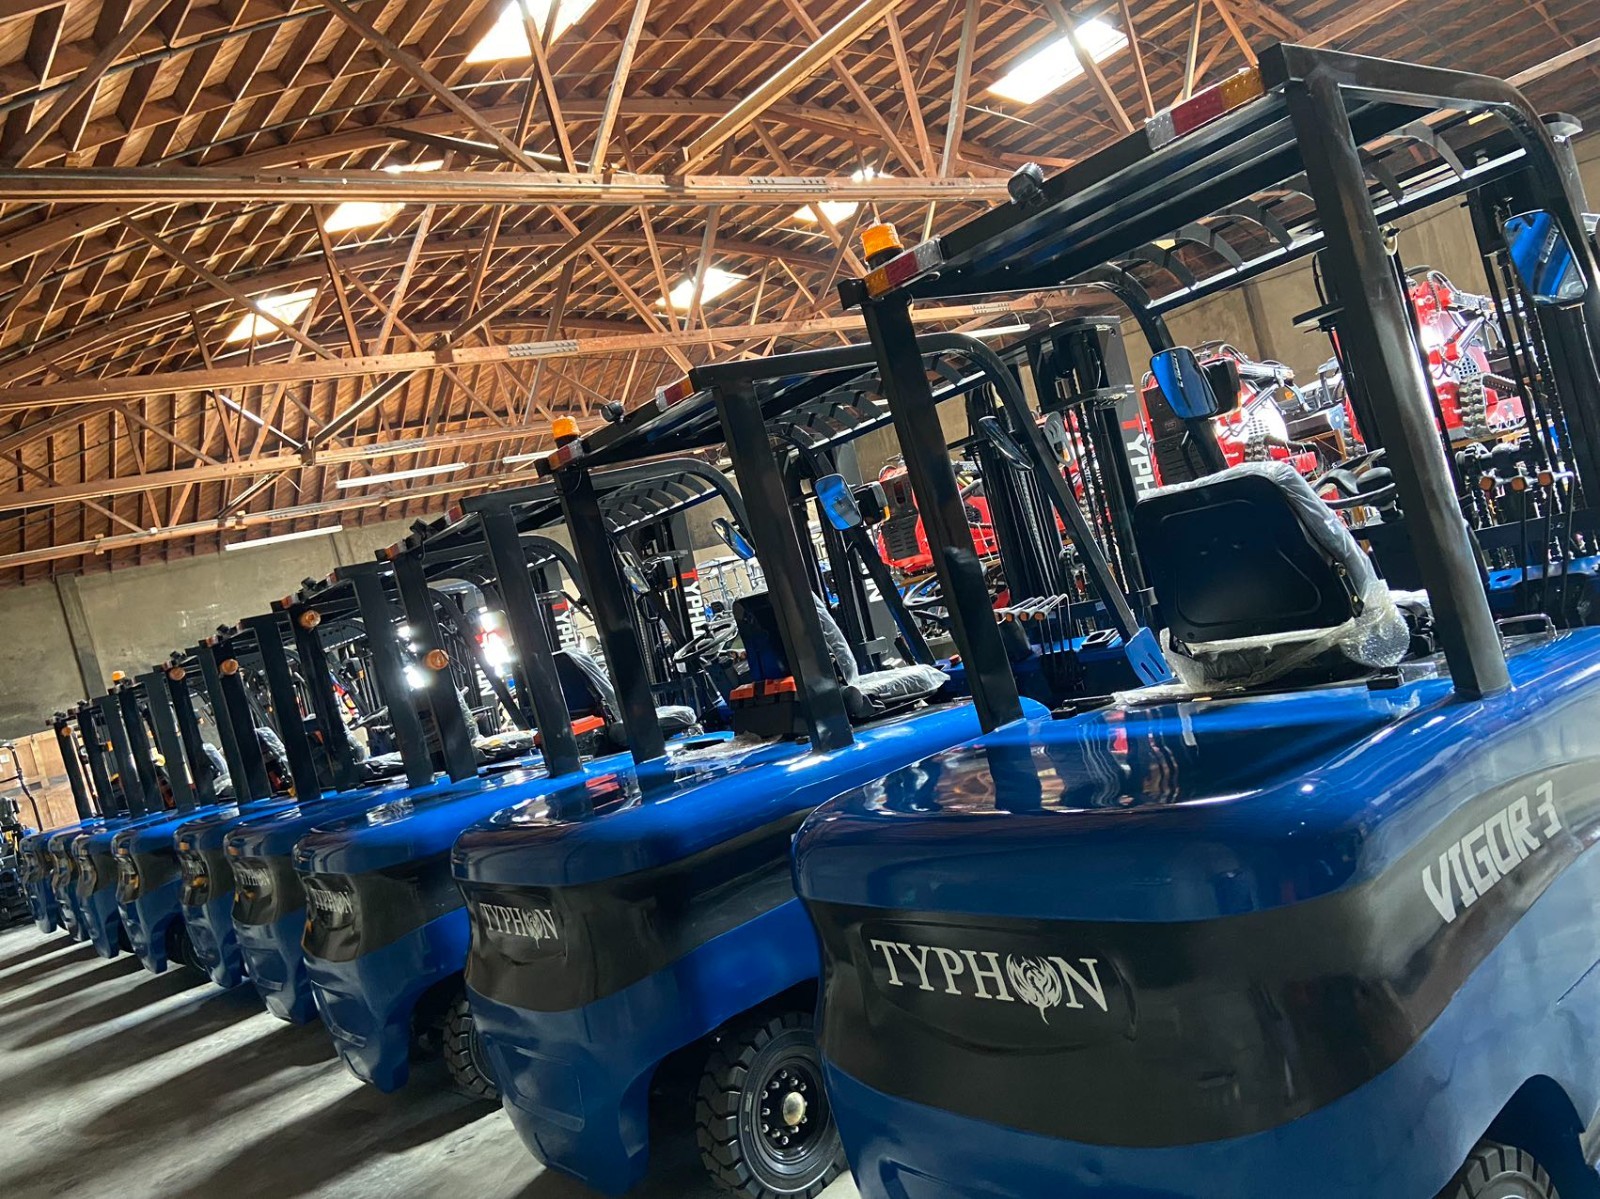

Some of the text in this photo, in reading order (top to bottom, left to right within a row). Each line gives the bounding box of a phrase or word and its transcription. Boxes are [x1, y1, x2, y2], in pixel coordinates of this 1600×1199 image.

[1121, 413, 1155, 498] TYPH
[551, 599, 576, 648] TYPH
[1421, 779, 1563, 924] VIGOR 3
[870, 938, 1109, 1023] TYPHON
